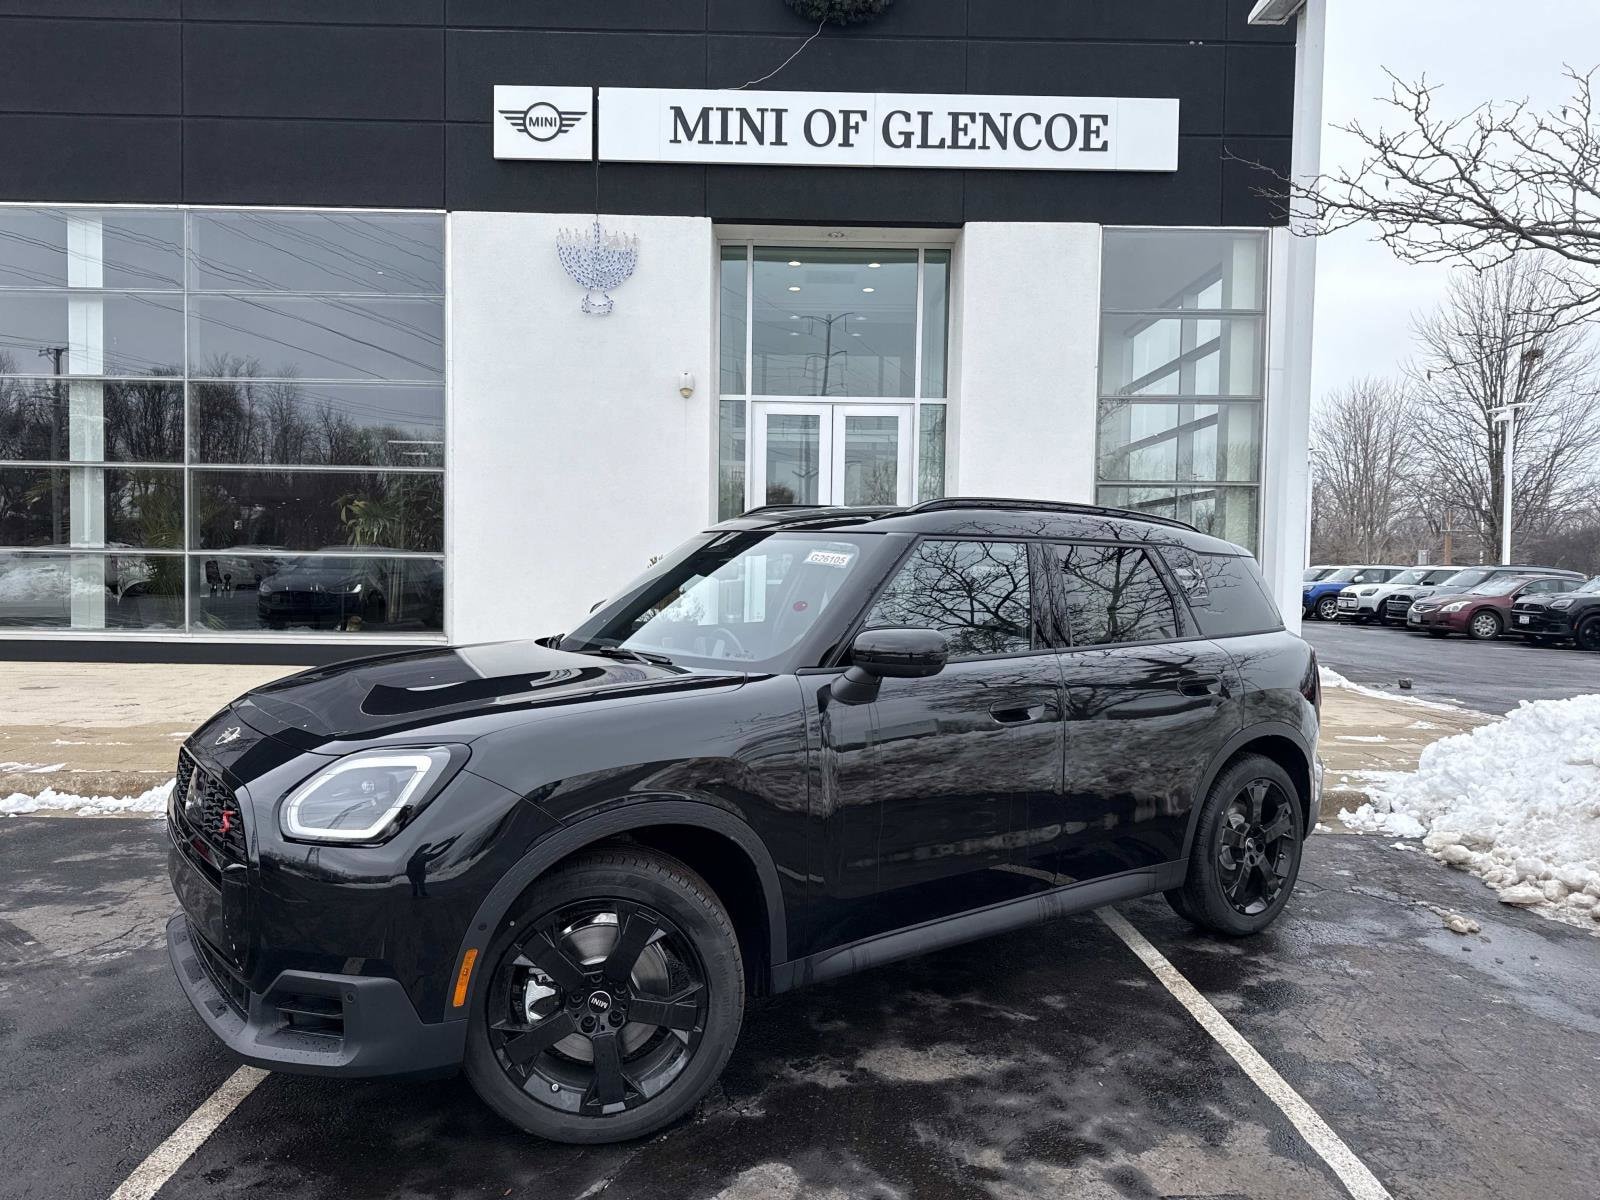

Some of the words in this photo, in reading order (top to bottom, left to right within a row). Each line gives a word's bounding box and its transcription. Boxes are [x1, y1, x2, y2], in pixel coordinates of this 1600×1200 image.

[528, 116, 557, 128] MINI
[668, 105, 789, 147] MINI
[803, 108, 868, 148] OF
[881, 109, 1110, 153] GLENCOE
[810, 553, 848, 565] G26105
[590, 997, 609, 1009] MINI
